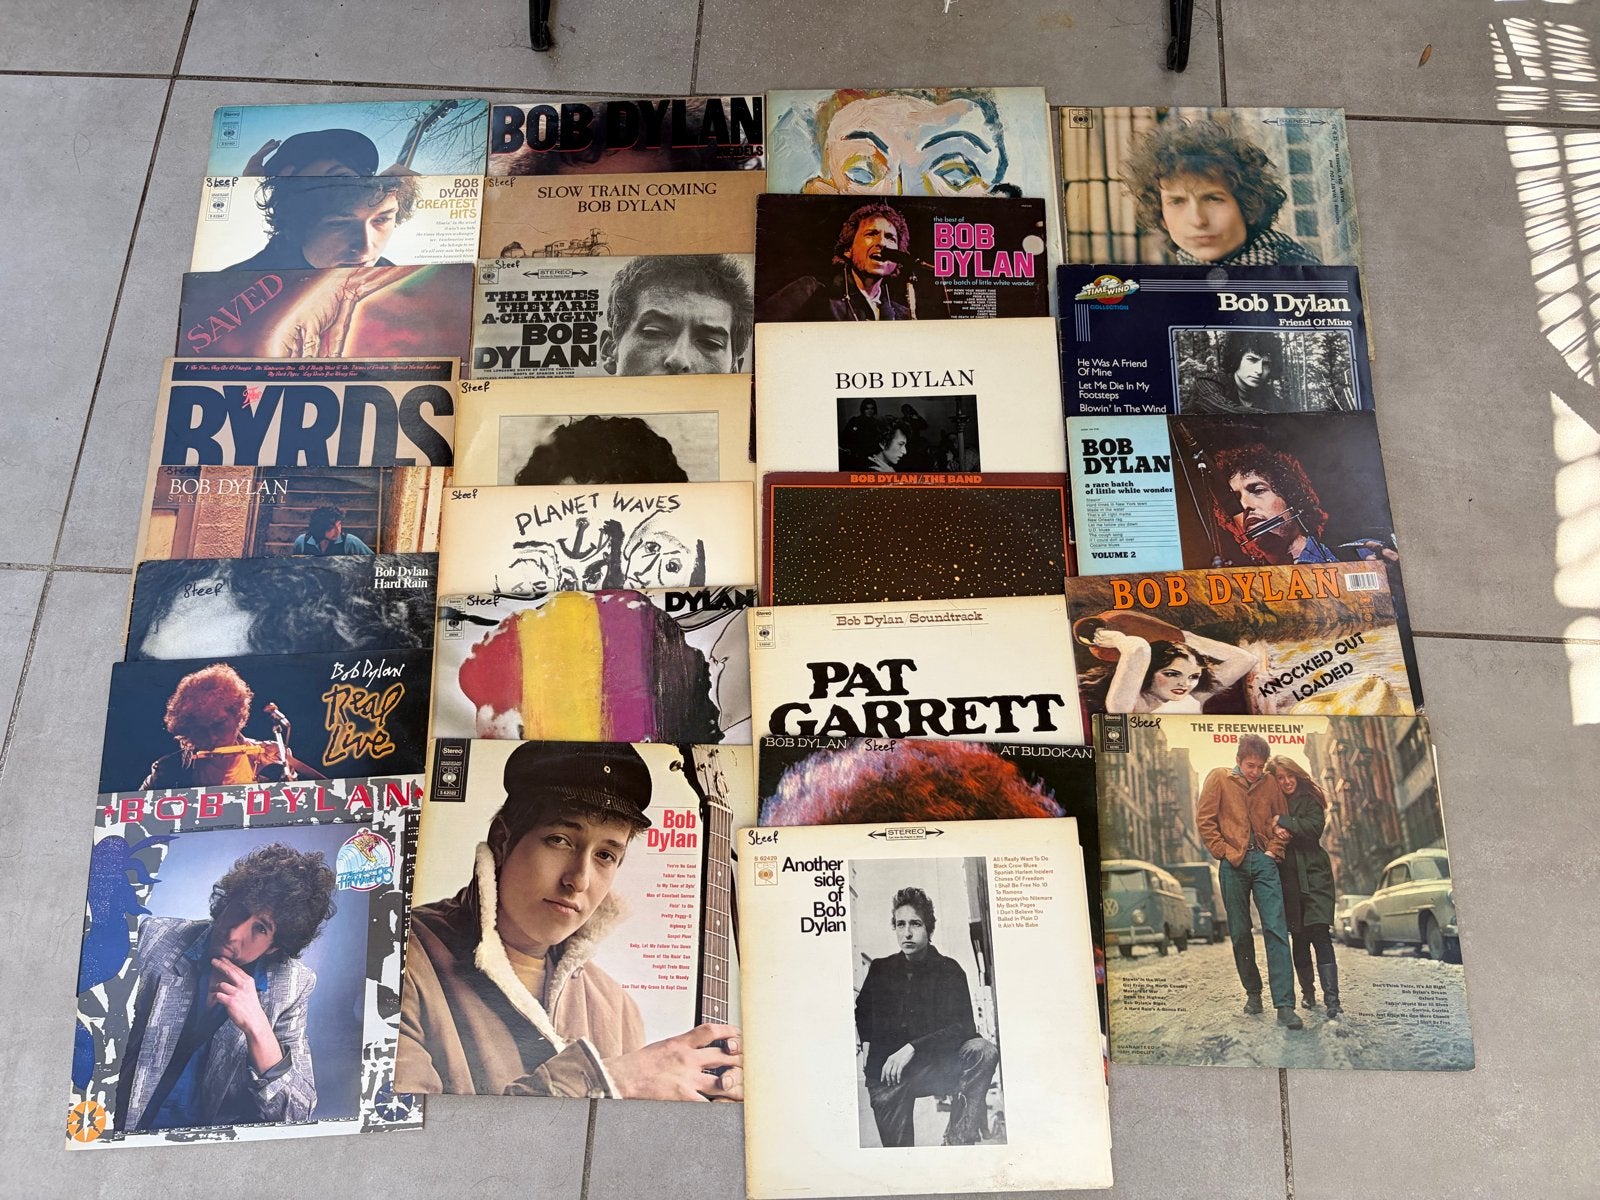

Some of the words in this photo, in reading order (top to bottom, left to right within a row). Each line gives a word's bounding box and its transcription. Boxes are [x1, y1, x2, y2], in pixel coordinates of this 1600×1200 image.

[492, 103, 594, 153] BOB
[606, 97, 763, 150] DYLAN
[206, 178, 239, 188] Steef
[454, 178, 479, 188] BOB
[537, 185, 583, 199] SLOW
[588, 184, 640, 198] TRAIN
[646, 182, 717, 196] COMING
[440, 188, 478, 198] DYLAN
[416, 198, 478, 209] GREATEST
[578, 201, 611, 213] BOB
[617, 199, 676, 212] DYLAN
[450, 209, 477, 219] HITS
[934, 223, 995, 250] BOB
[495, 260, 520, 270] Steef
[934, 250, 1035, 278] DYLAN
[485, 291, 528, 302] THE
[532, 289, 600, 301] TIMES
[496, 302, 554, 312] THEY
[555, 301, 598, 312] ARE
[1217, 293, 1268, 312] Bob
[1273, 294, 1350, 318] Dylan
[186, 274, 284, 353] SAVED
[482, 311, 603, 324] A-CHANGIN'
[1279, 318, 1311, 326] Friend
[1314, 318, 1326, 326] Of
[522, 322, 598, 345] BOB
[474, 345, 597, 369] DYLAN
[1078, 359, 1090, 368] He
[1091, 359, 1110, 368] Was
[1121, 359, 1147, 368] Friend
[835, 372, 884, 390] BOB
[891, 369, 975, 388] DYLAN
[1078, 368, 1090, 377] Of
[1093, 368, 1112, 377] Mine
[461, 382, 490, 394] Steef
[1078, 382, 1091, 390] Let
[1094, 382, 1108, 390] Me
[1136, 383, 1150, 392] My
[1079, 390, 1119, 401] Footsteps
[1080, 404, 1112, 412] Blowin'
[1114, 404, 1122, 412] In
[1124, 404, 1141, 412] The
[1143, 404, 1167, 413] Wind
[1082, 438, 1133, 456] BOB
[1083, 456, 1170, 474] DYLAN
[850, 474, 875, 482] BOB
[948, 475, 982, 483] BAND
[170, 479, 210, 494] BOB
[218, 479, 288, 494] DYLAN
[515, 493, 599, 535] PLANET
[613, 491, 681, 512] WAVES
[374, 566, 396, 577] Bob
[398, 566, 429, 579] Dylan
[184, 582, 225, 598] Steef
[374, 578, 401, 589] Hard
[404, 578, 428, 588] Rain
[1110, 576, 1189, 610] BOB
[1207, 567, 1341, 606] DYLAN
[467, 594, 500, 607] Steef
[665, 590, 754, 612] DYLAN
[836, 615, 862, 626] Bob
[864, 614, 904, 628] Dylan
[1258, 651, 1334, 698] KNOCKED
[1334, 632, 1366, 655] OUT
[330, 661, 359, 680] Bob
[361, 658, 405, 688] Dylan
[806, 658, 917, 699] PAT
[1292, 662, 1354, 702] LOADED
[322, 682, 405, 728] Real
[769, 694, 1065, 738] GARRETT
[1190, 723, 1215, 732] THE
[1218, 723, 1304, 733] FREEWHEELIN'
[322, 724, 396, 766] Live
[765, 738, 794, 748] BOB
[797, 738, 847, 749] DYLAN
[864, 738, 896, 752] Steef
[1213, 734, 1238, 743] BOB
[1268, 735, 1305, 744] DYLAN
[1001, 746, 1019, 756] AT
[1021, 746, 1093, 759] BUDOKAN
[120, 792, 224, 823] BOB
[246, 781, 411, 816] DYLAN
[664, 810, 696, 829] Bob
[648, 828, 697, 852] Dylan
[748, 830, 778, 845] Steef
[782, 856, 843, 872] Another
[814, 872, 844, 887] side
[828, 886, 844, 902] of
[814, 901, 846, 917] Bob
[801, 916, 846, 936] Dylan
